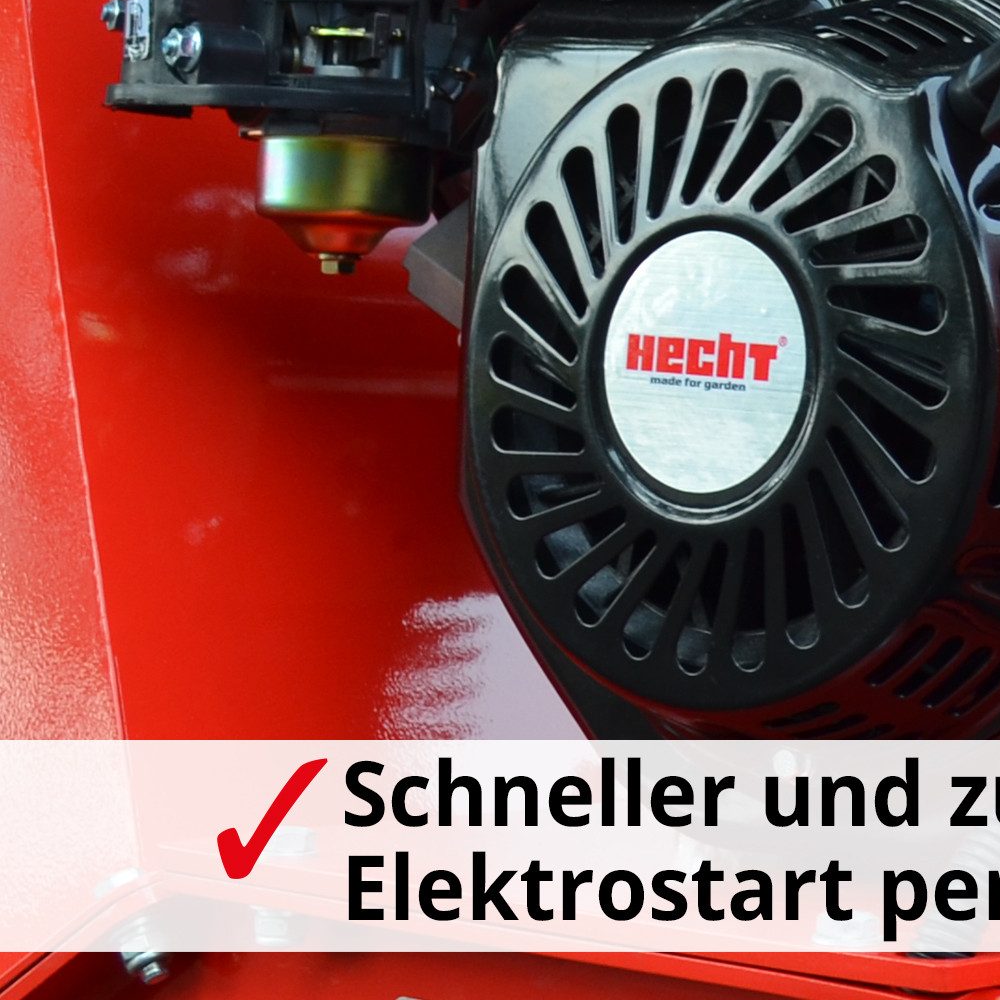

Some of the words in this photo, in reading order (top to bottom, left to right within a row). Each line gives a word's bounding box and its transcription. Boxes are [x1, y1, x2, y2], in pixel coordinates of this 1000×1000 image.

[650, 376, 682, 387] made
[684, 377, 701, 388] for
[704, 381, 746, 392] garden
